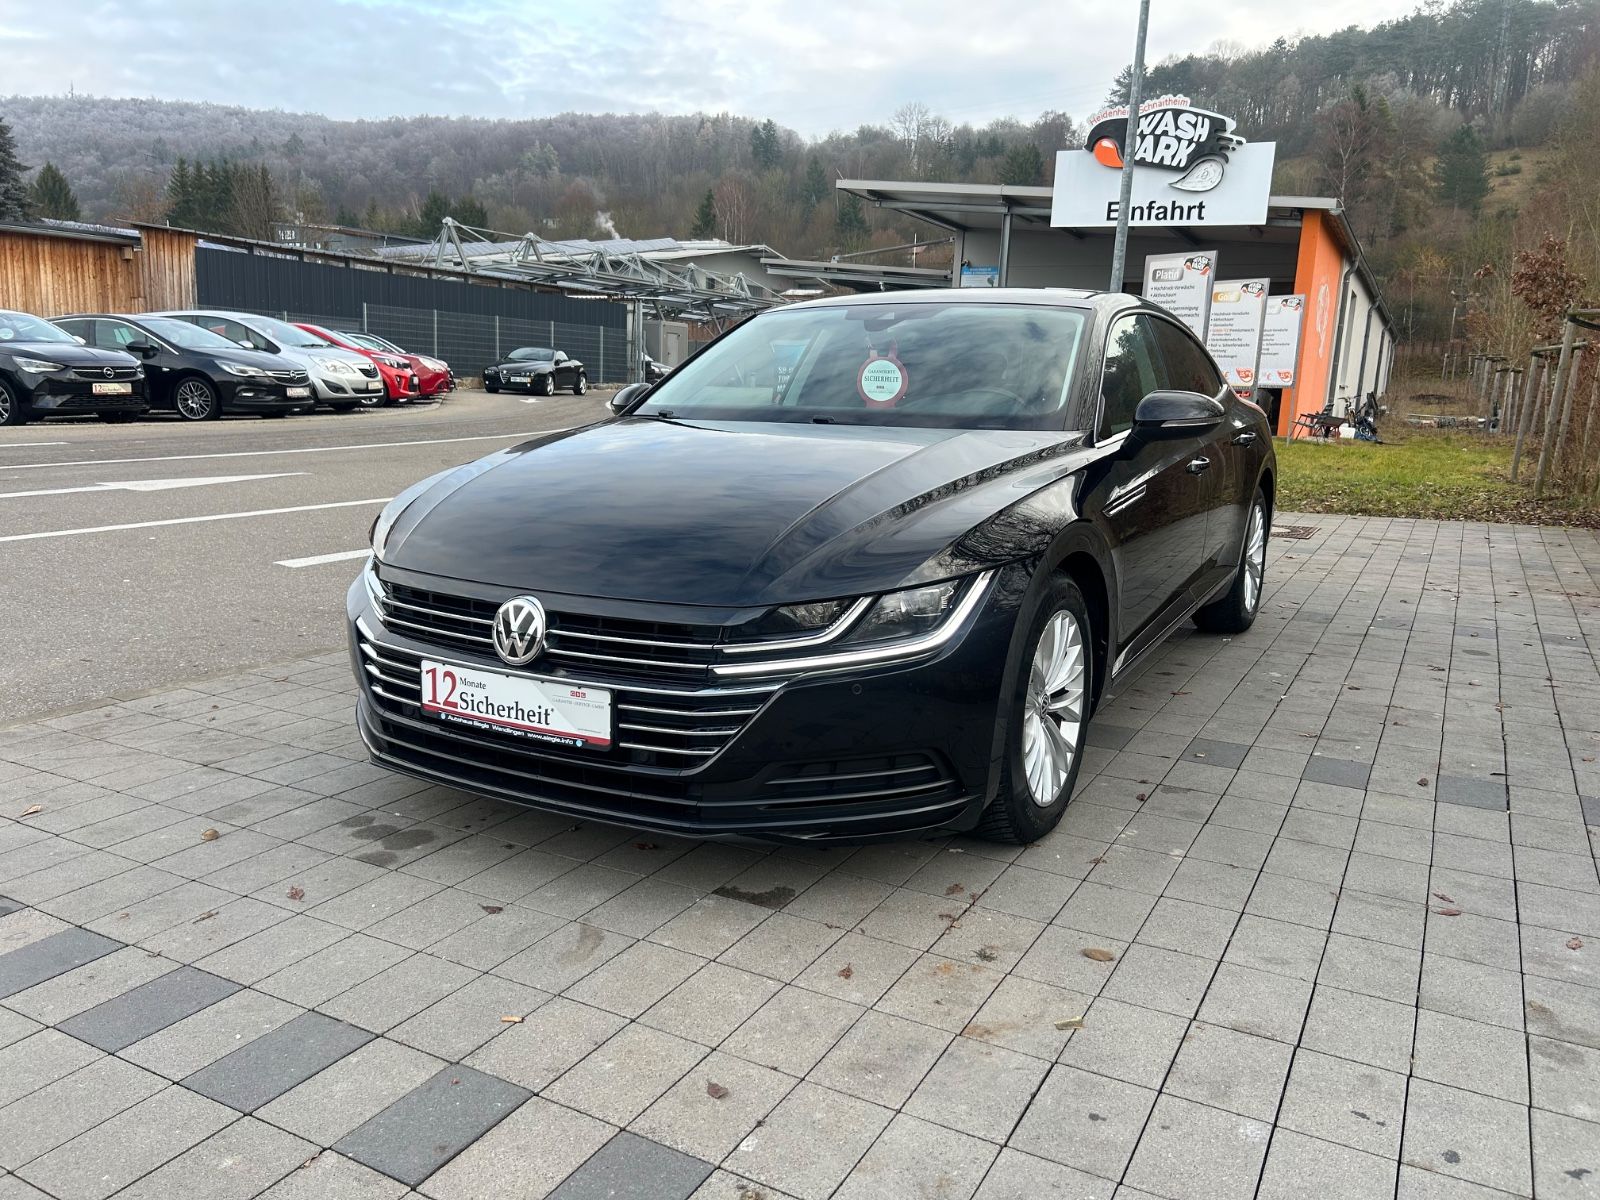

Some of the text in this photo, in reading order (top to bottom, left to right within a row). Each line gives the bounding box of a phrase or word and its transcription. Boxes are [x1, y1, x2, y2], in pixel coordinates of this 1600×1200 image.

[1089, 108, 1130, 126] Heidenhei
[1136, 110, 1210, 142] WASH
[1106, 200, 1206, 221] Enfahrt
[1155, 268, 1180, 280] Platin
[864, 375, 899, 383] SICHERHEIT
[425, 667, 459, 710] 12
[459, 677, 487, 690] Monate
[447, 714, 473, 726] Autohaus
[491, 723, 525, 737] Wendlingen
